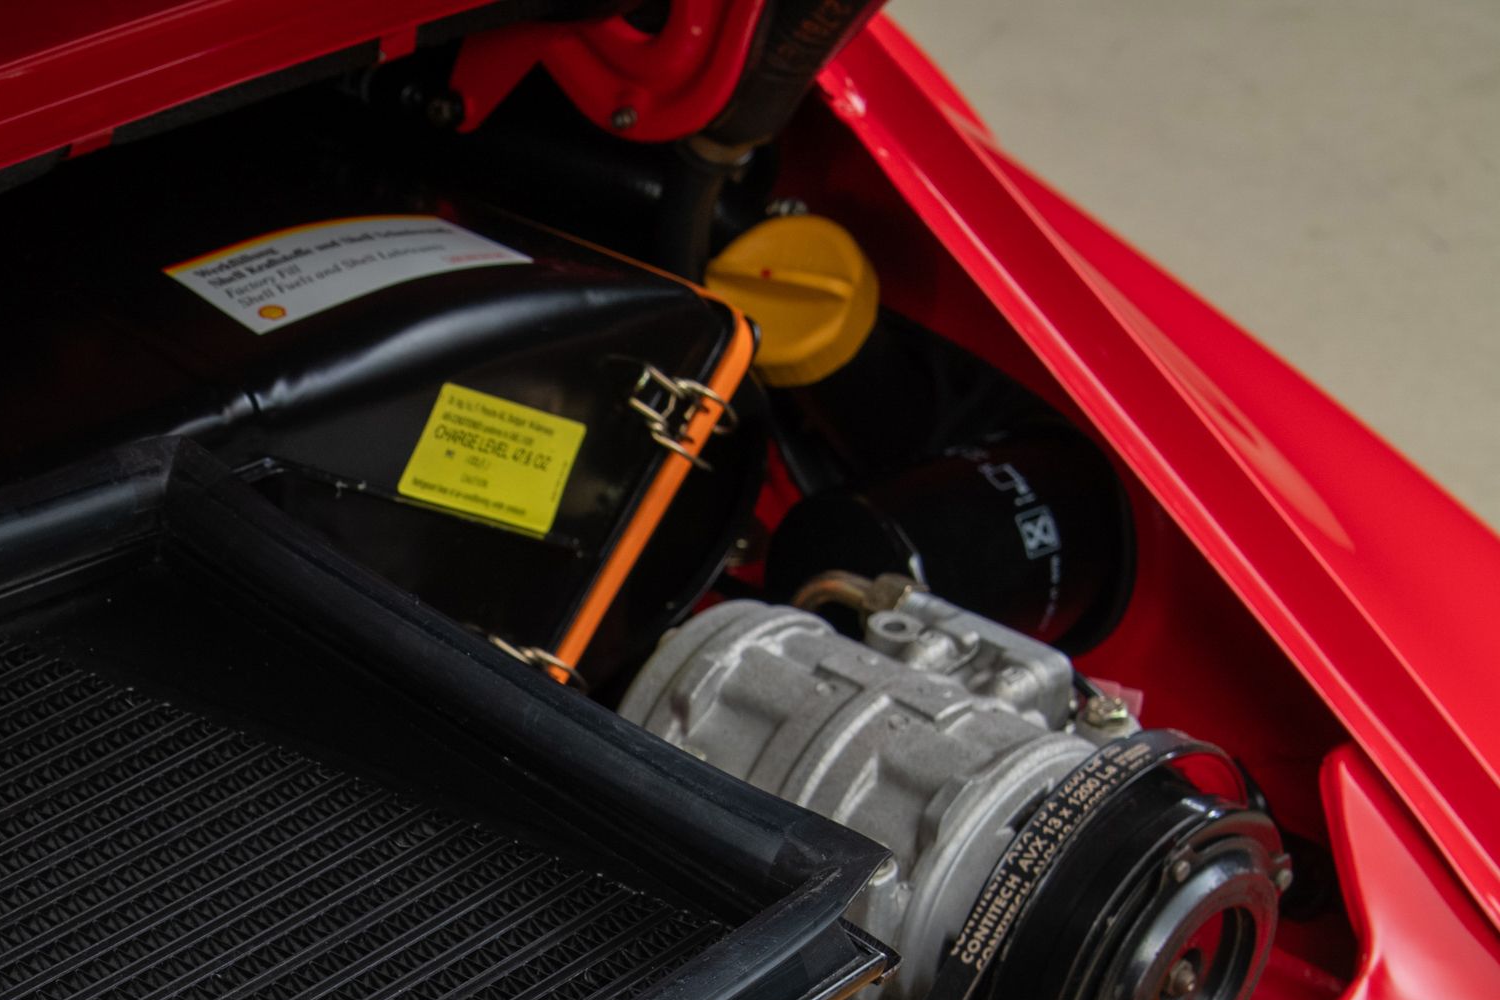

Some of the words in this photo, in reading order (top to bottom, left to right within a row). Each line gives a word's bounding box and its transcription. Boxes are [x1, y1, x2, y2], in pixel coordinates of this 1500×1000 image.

[225, 275, 277, 299] Factory
[276, 263, 302, 279] Fill
[237, 288, 275, 309] Shell
[275, 275, 314, 294] Fuels
[315, 263, 342, 280] and
[341, 254, 378, 270] Shell
[434, 424, 478, 449] CHARGE
[478, 436, 509, 459] LEVEL
[961, 873, 1021, 964] CONTITECH
[1018, 836, 1048, 873] AVX
[1042, 817, 1063, 835] 13
